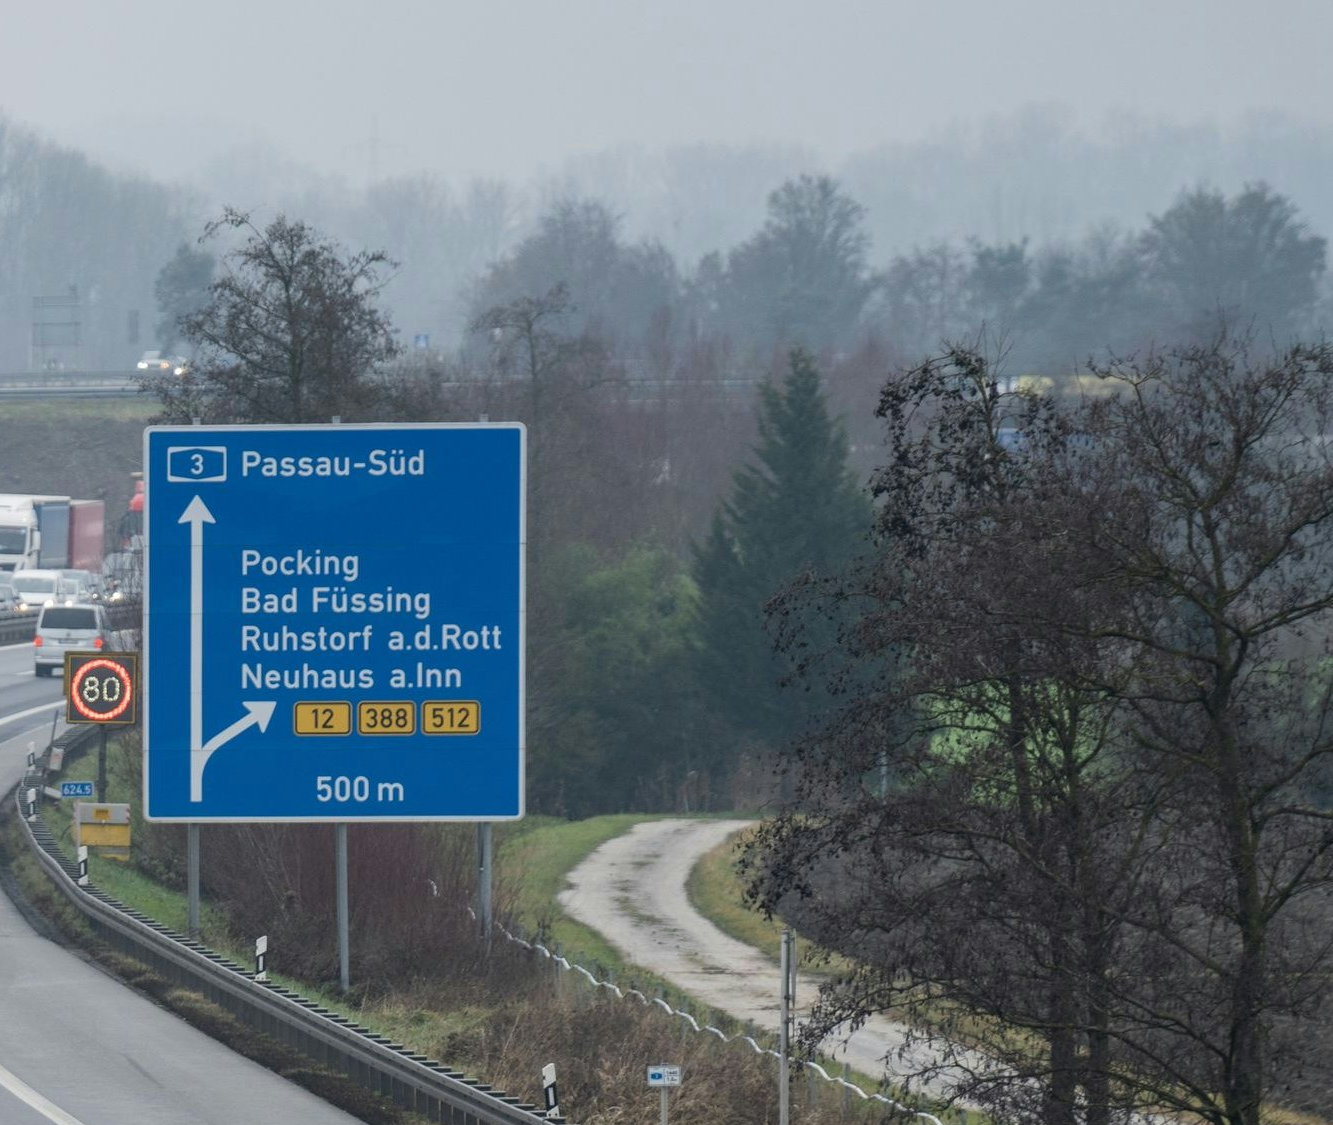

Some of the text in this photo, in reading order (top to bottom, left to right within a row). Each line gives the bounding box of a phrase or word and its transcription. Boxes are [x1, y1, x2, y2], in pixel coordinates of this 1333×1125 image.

[190, 453, 204, 475] 3
[241, 449, 426, 477] Passau-Süd
[240, 549, 360, 582] Pocking
[240, 586, 431, 619] Bad Füssing
[240, 624, 502, 652] Ruhstorf a.d.Rott
[83, 676, 120, 703] 80
[240, 662, 463, 690] Neuhaus a.Inn
[311, 708, 335, 730] 12
[365, 707, 408, 730] 388
[431, 707, 471, 729] 512
[315, 776, 405, 803] 500 m
